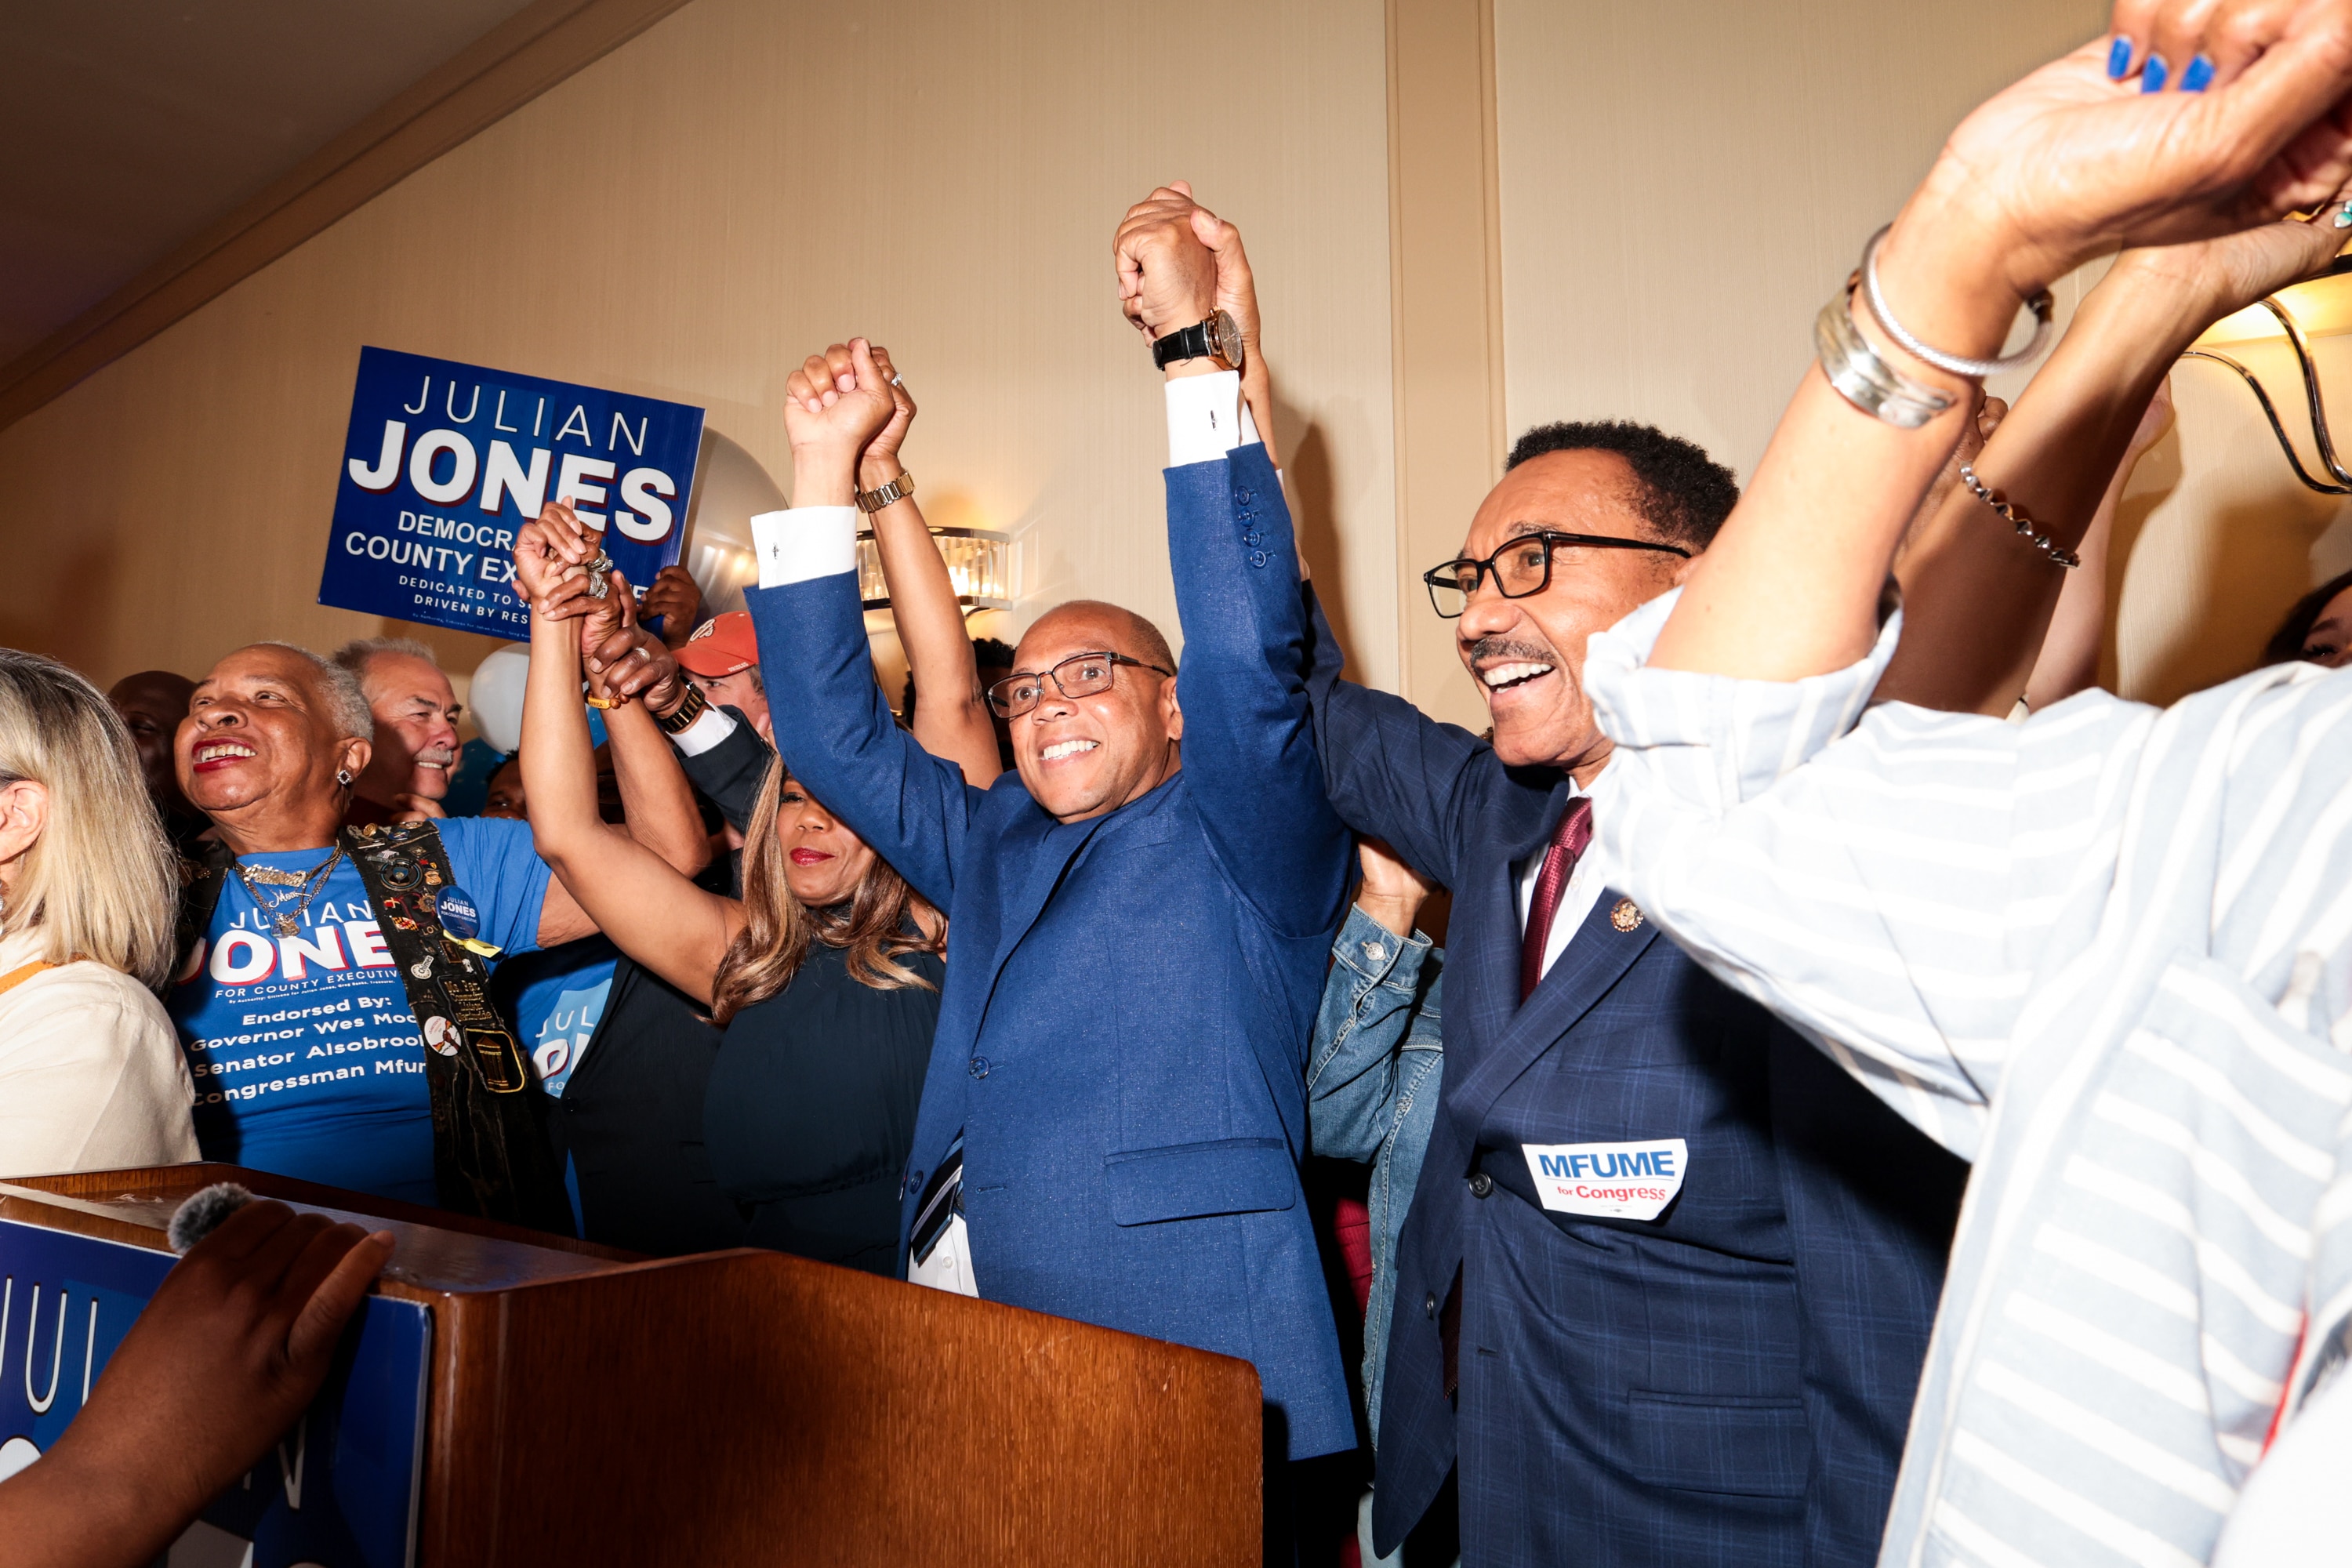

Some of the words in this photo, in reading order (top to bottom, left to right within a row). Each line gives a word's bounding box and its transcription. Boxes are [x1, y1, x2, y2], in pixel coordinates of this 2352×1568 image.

[404, 376, 648, 456] JULIAN
[348, 419, 677, 543] JONES
[397, 510, 516, 552] DEMOCR
[346, 532, 474, 575] COUNTY
[398, 575, 485, 600] DEDICATED
[492, 593, 511, 605] TO
[414, 594, 470, 613] DRIVEN
[477, 606, 495, 618] BY
[230, 900, 372, 930] JUIAN
[440, 901, 476, 918] JONES
[447, 896, 469, 906] JULIAN
[215, 988, 245, 999] FOR
[254, 979, 318, 994] COUNTY
[242, 999, 350, 1025] Endorsed
[358, 996, 392, 1011] By:
[190, 1027, 304, 1051] Governor
[314, 1017, 365, 1035] Wes
[194, 1051, 295, 1077] Senator
[1538, 1151, 1675, 1178] MFUME
[1557, 1186, 1573, 1196] for
[1576, 1185, 1666, 1202] Congress
